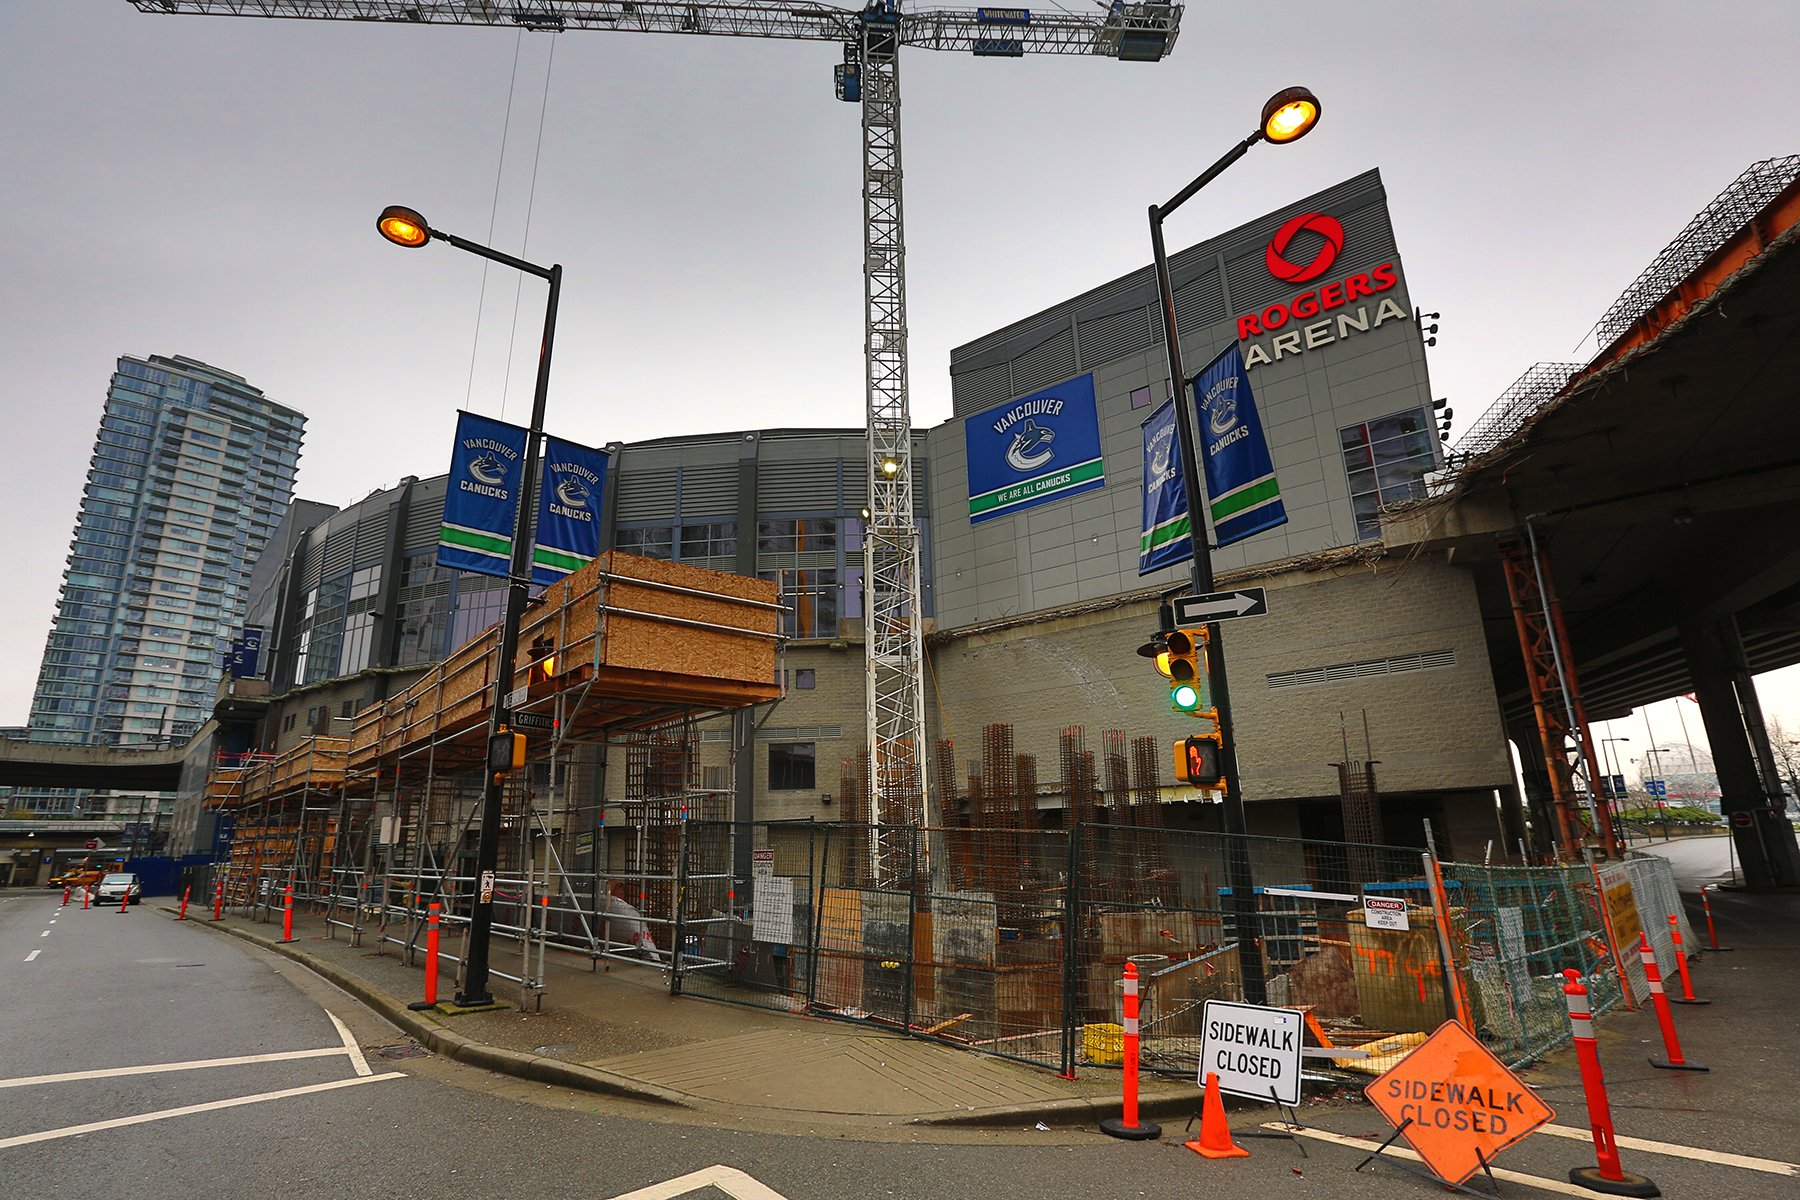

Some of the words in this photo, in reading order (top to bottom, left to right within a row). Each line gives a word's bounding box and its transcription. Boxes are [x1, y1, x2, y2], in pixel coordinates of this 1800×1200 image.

[983, 9, 1025, 19] WHITEWATER
[1236, 262, 1398, 341] ROGERS
[1244, 298, 1408, 371] ARENA
[1200, 376, 1239, 411] VANCOUVER
[993, 399, 1064, 434] VANCOUVER
[463, 438, 518, 462] VANCOUVER
[1210, 424, 1249, 456] CANUCKS
[550, 462, 600, 485] VANCOUVER
[997, 492, 1008, 502] WE
[1008, 487, 1022, 499] ARE
[1023, 484, 1034, 496] ALL
[1036, 473, 1071, 491] CANUCKS
[460, 480, 508, 500] CANUCKS
[549, 503, 592, 522] CANUCKS
[754, 852, 774, 860] DANGER
[1371, 901, 1400, 909] DANGER
[1209, 1021, 1293, 1052] SIDEWALK
[1216, 1050, 1281, 1079] CLOSED
[1388, 1079, 1524, 1114] SIDEWALK
[1401, 1104, 1507, 1135] CLOSED
